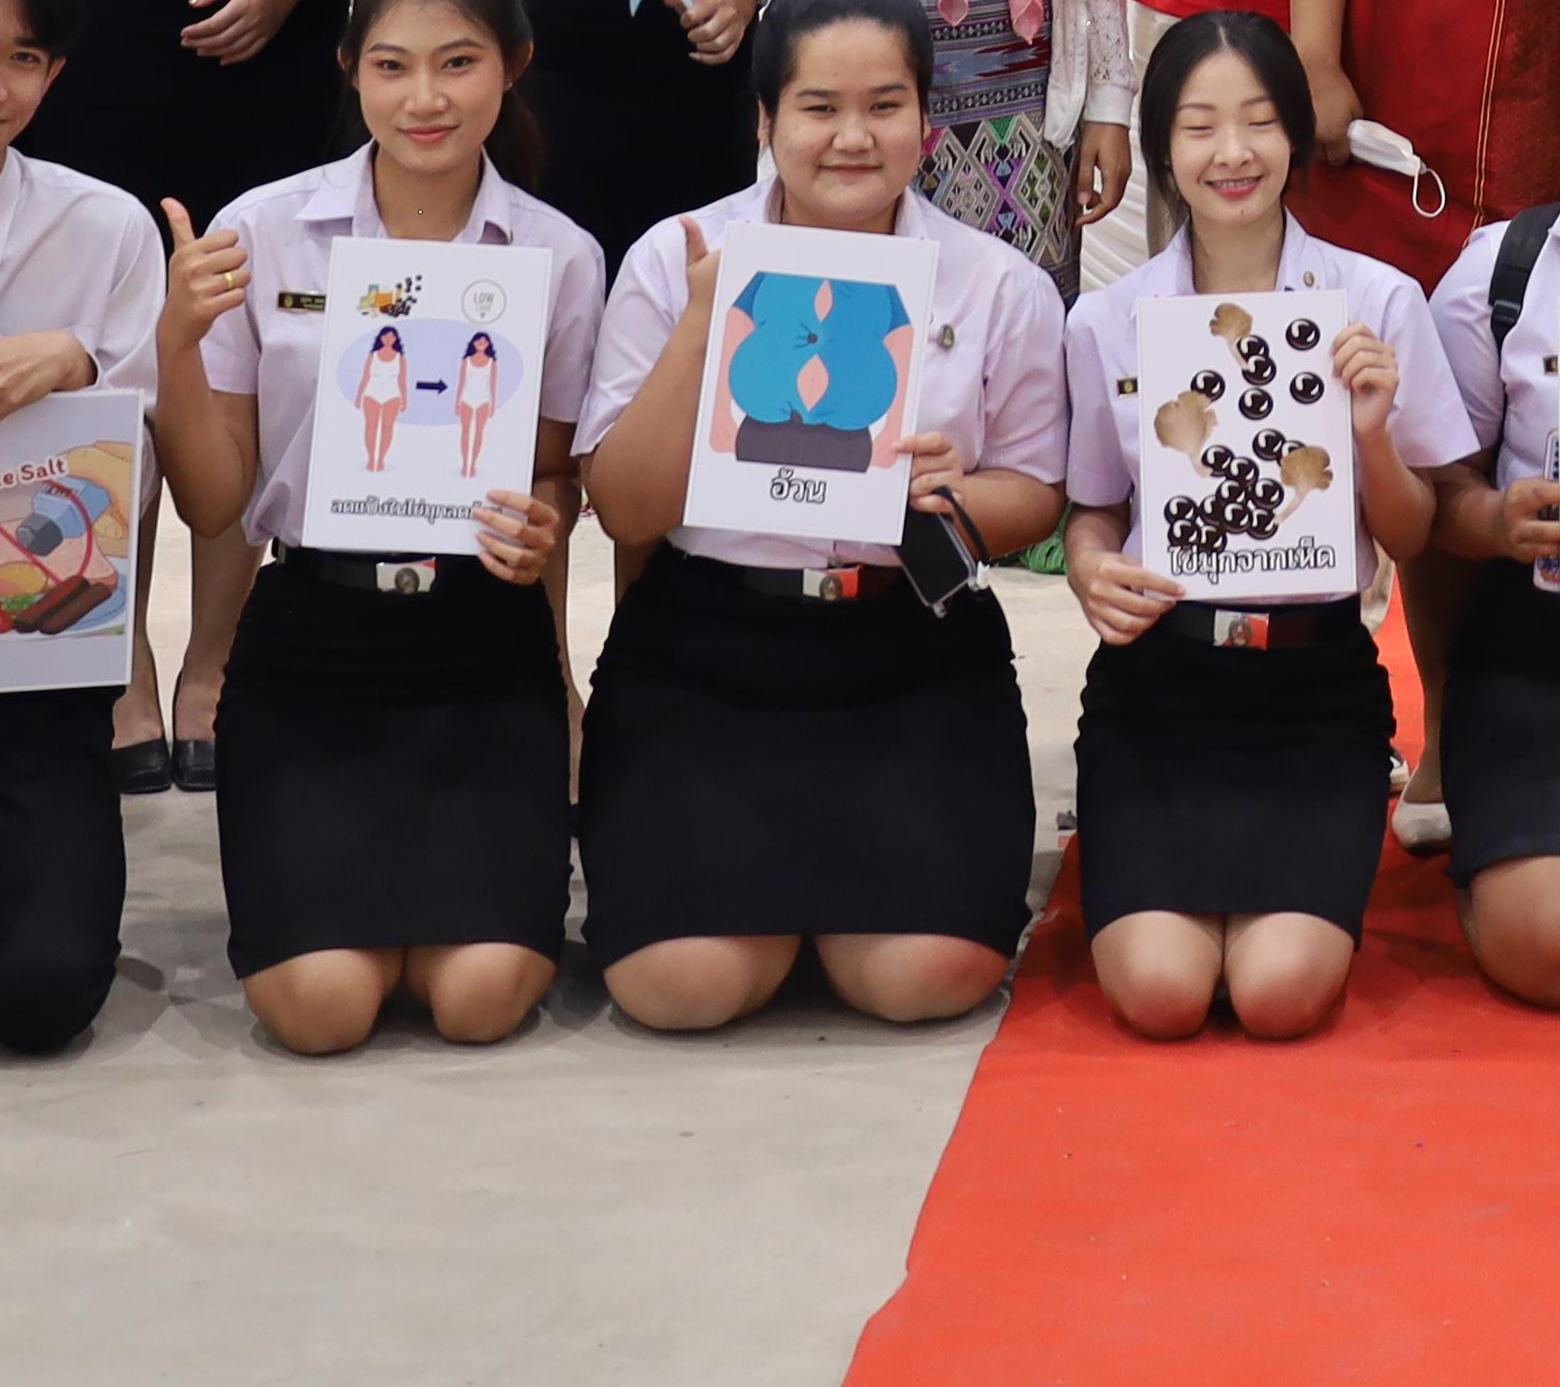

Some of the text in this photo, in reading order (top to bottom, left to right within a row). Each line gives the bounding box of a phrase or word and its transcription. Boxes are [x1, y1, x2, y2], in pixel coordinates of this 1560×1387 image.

[20, 457, 67, 481] Salt
[769, 466, 827, 505] อ้วน
[1168, 536, 1336, 584] ไข่มุกจากเห็ด
